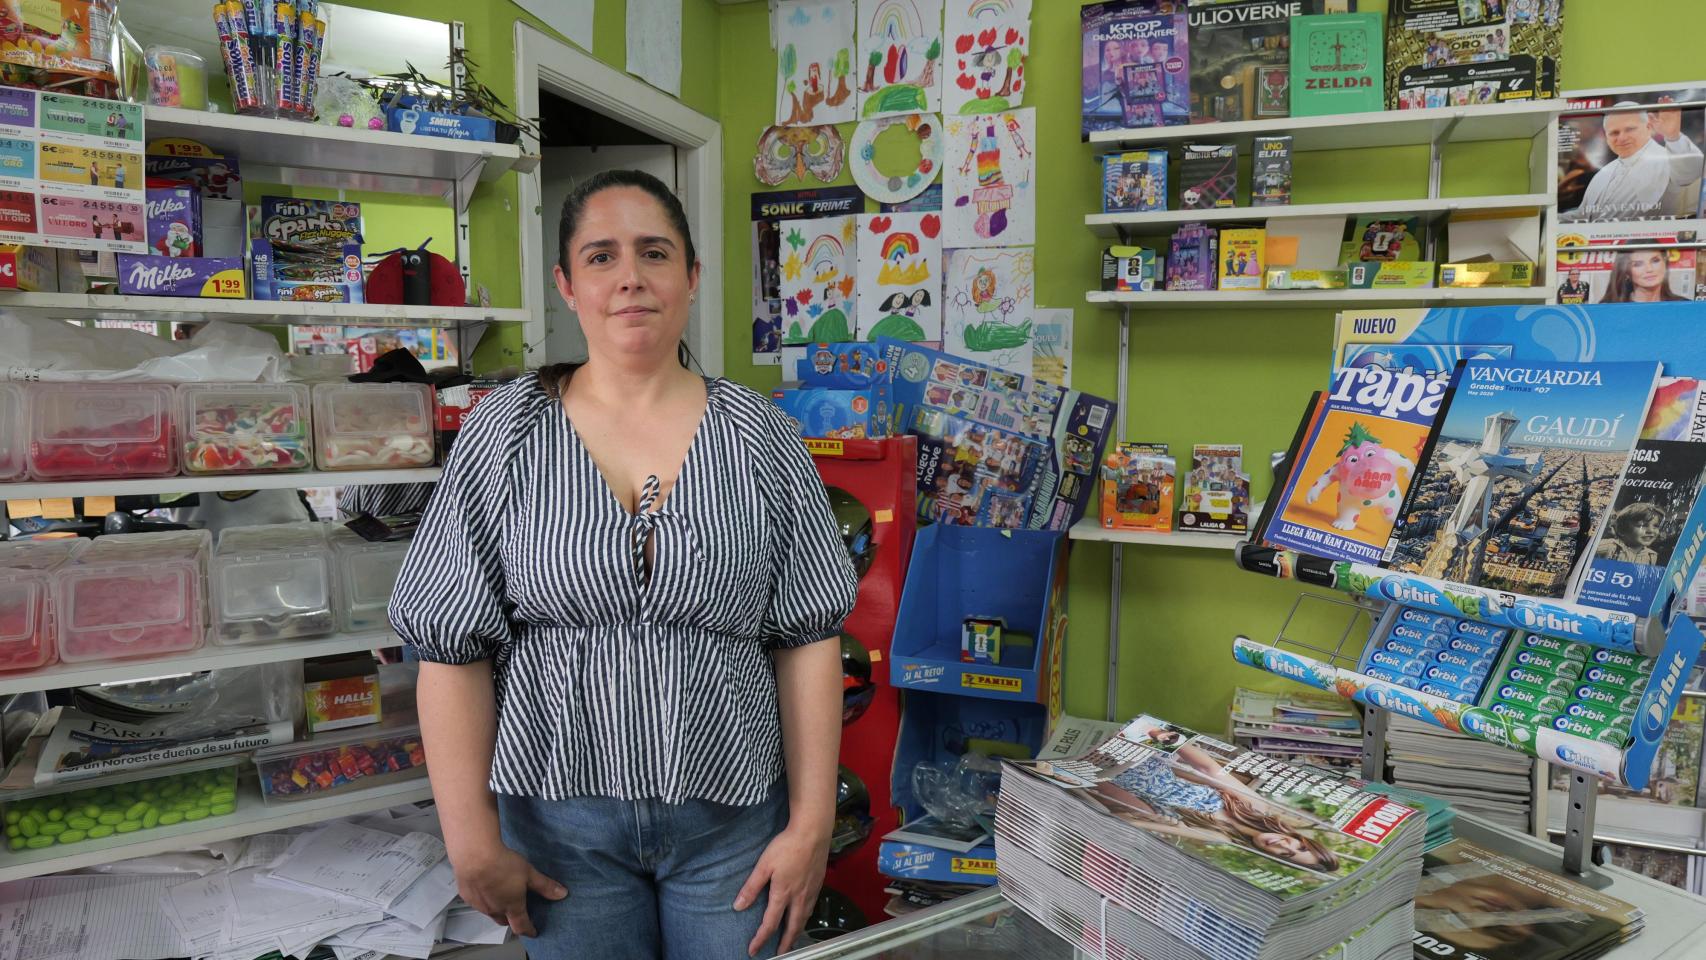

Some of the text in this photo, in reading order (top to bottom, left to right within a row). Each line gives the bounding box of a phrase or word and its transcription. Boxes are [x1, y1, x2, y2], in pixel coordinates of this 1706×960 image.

[1188, 9, 1234, 26] ULIO
[1235, 2, 1302, 21] VERNE
[1093, 28, 1178, 41] DEMON HUNTERS
[1451, 40, 1480, 49] ORO
[227, 39, 248, 99] mentos
[282, 42, 292, 100] mentos
[1305, 76, 1372, 90] ZELDA
[1258, 150, 1287, 158] ELITE
[275, 202, 305, 216] Fini
[761, 200, 852, 217] SONIC PRIME
[129, 261, 196, 289] Milka
[1353, 318, 1396, 334] NUEVO
[1470, 367, 1603, 386] VANGUARDIA
[1329, 366, 1450, 418] Tapa
[1527, 413, 1625, 439] GAUDÍ
[1556, 436, 1614, 447] ARCHITECT
[1632, 449, 1660, 462] RCAS
[1627, 463, 1647, 474] ico
[1623, 478, 1674, 490] ocracia
[1281, 523, 1382, 560] LLEGA ÑAM ÑAM FESTIVAL
[1672, 522, 1706, 594] Orbit
[1611, 572, 1633, 588] 50
[1382, 577, 1440, 606] Orbit
[1401, 608, 1430, 623] Orbit
[1513, 604, 1583, 635] Orbit
[1393, 624, 1422, 640] Orbit
[1456, 620, 1488, 637] Orbit
[1385, 640, 1414, 655] Orbit
[1449, 637, 1480, 653] Orbit
[1524, 633, 1560, 650] Orbit
[1266, 651, 1304, 678] Orbit
[1372, 651, 1400, 667] Orbit
[1436, 650, 1467, 666] Orbit
[1516, 650, 1552, 668] Orbit
[1592, 649, 1633, 666] Orbit
[914, 670, 922, 680] AL
[924, 667, 945, 677] RETO!
[978, 676, 1019, 687] PANINI
[1365, 667, 1392, 682] Orbit
[1426, 665, 1458, 682] Orbit
[1508, 667, 1544, 685] Orbit
[1585, 667, 1626, 685] Orbit
[334, 691, 373, 705] HALLS
[1419, 683, 1450, 699] Orbit
[1498, 684, 1534, 703] Orbit
[1575, 685, 1615, 703] Orbit
[1647, 651, 1687, 731] Orbit
[1368, 685, 1423, 718] Orbit
[1491, 702, 1526, 721] Orbit
[1566, 703, 1606, 722] Orbit
[1465, 711, 1506, 739] Orbit
[1553, 715, 1593, 735] Orbit
[103, 752, 160, 768] Noroeste
[163, 745, 200, 759] dueño
[202, 743, 216, 754] de
[219, 742, 231, 751] su
[233, 738, 269, 750] futuro
[1259, 776, 1284, 794] NUEVA
[1272, 777, 1302, 800] PUERTAS
[1308, 777, 1342, 798] ROCA
[1321, 784, 1359, 806] NURIA
[904, 857, 912, 867] AL
[915, 852, 935, 865] RETO!
[1504, 868, 1537, 888] campo
[1537, 882, 1566, 896] como
